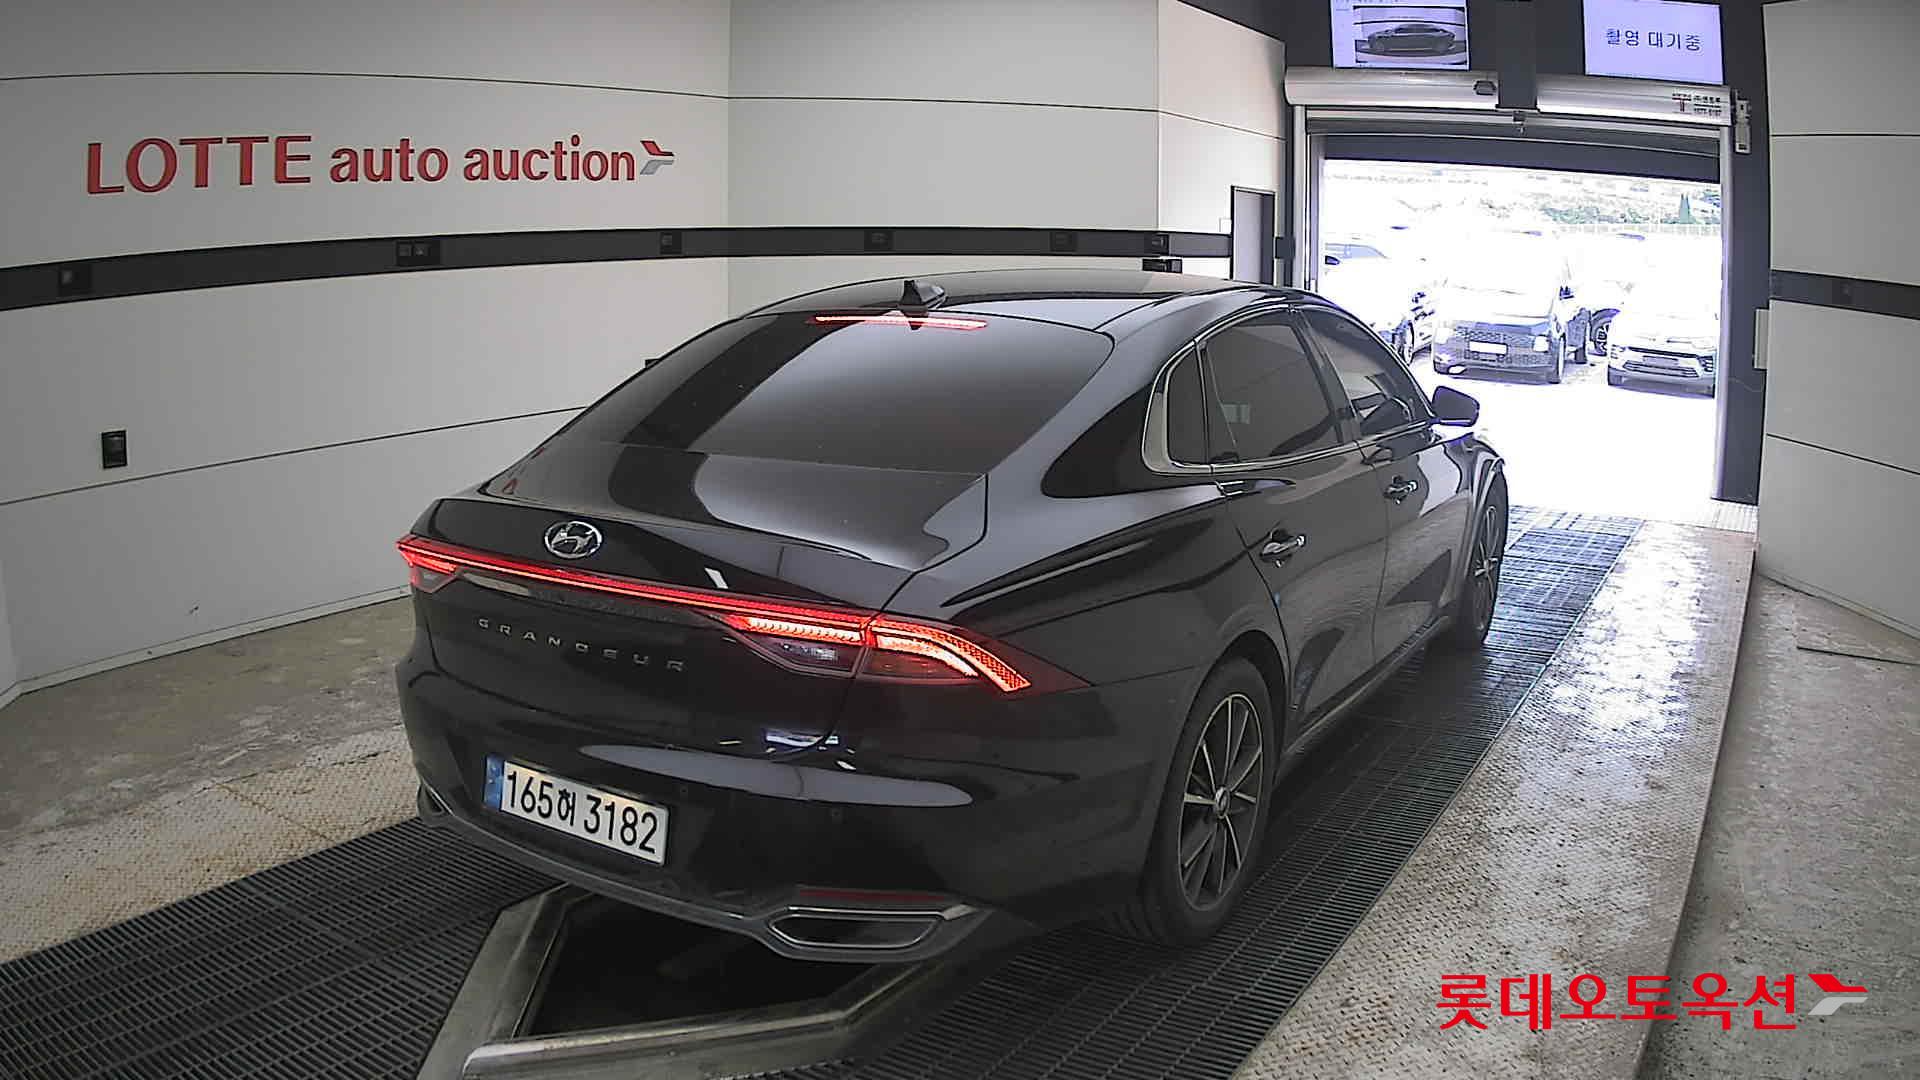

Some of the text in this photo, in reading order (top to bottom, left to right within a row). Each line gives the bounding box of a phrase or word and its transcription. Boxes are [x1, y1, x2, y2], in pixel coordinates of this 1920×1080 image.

[1648, 31, 1702, 52] 대기중
[87, 133, 635, 194] LOTTE auto auction
[477, 617, 685, 673] GRANDEUR
[507, 771, 657, 854] 165허 3182
